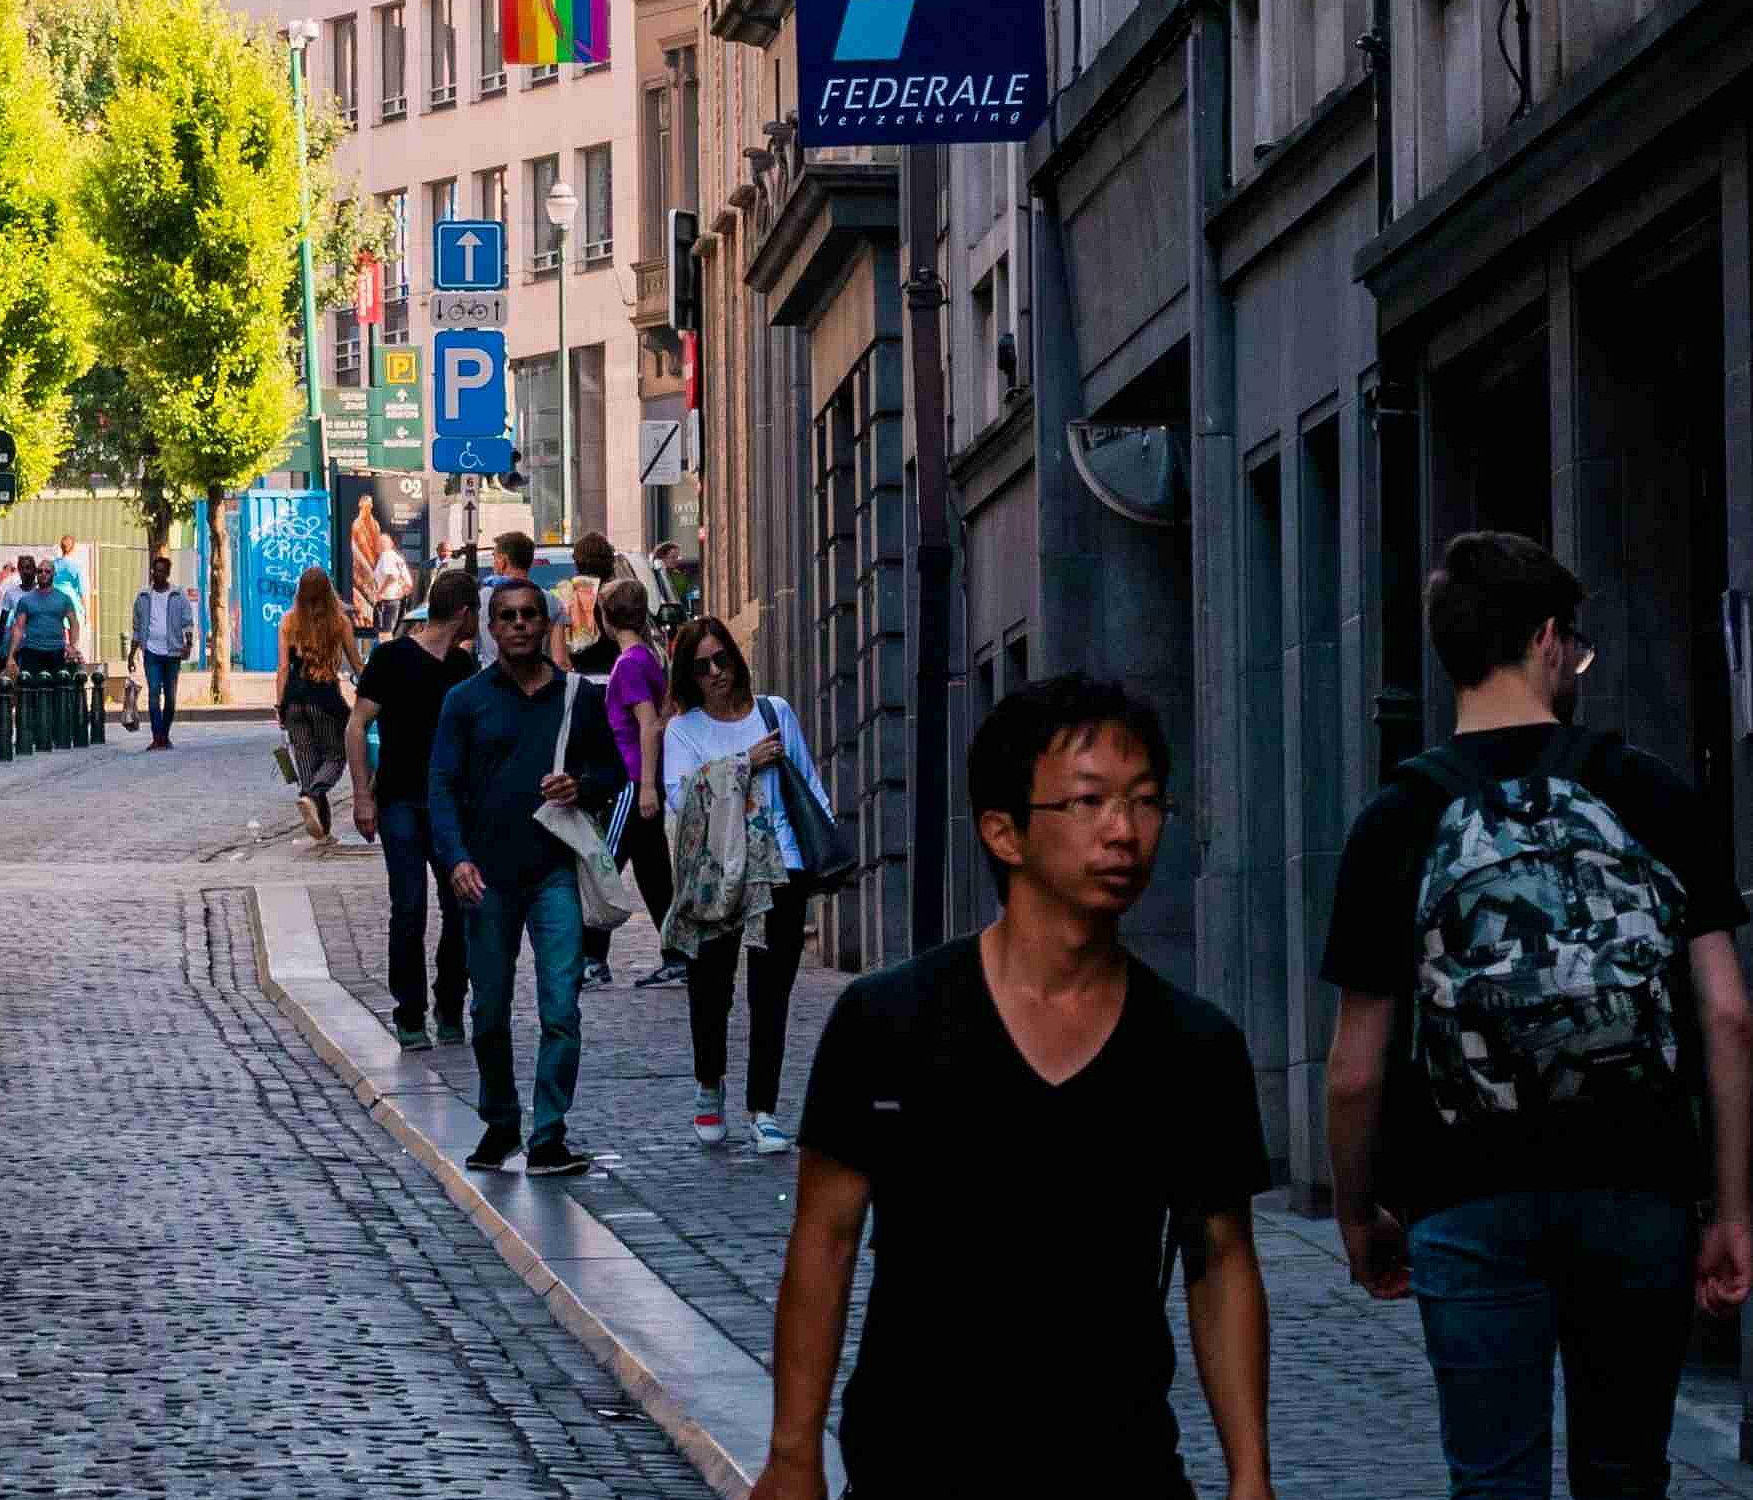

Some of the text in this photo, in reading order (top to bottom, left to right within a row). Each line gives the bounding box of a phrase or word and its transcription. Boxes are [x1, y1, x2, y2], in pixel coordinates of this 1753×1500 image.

[821, 74, 1030, 109] FEDERALE
[818, 111, 1021, 126] Verzekering
[445, 348, 493, 419] P
